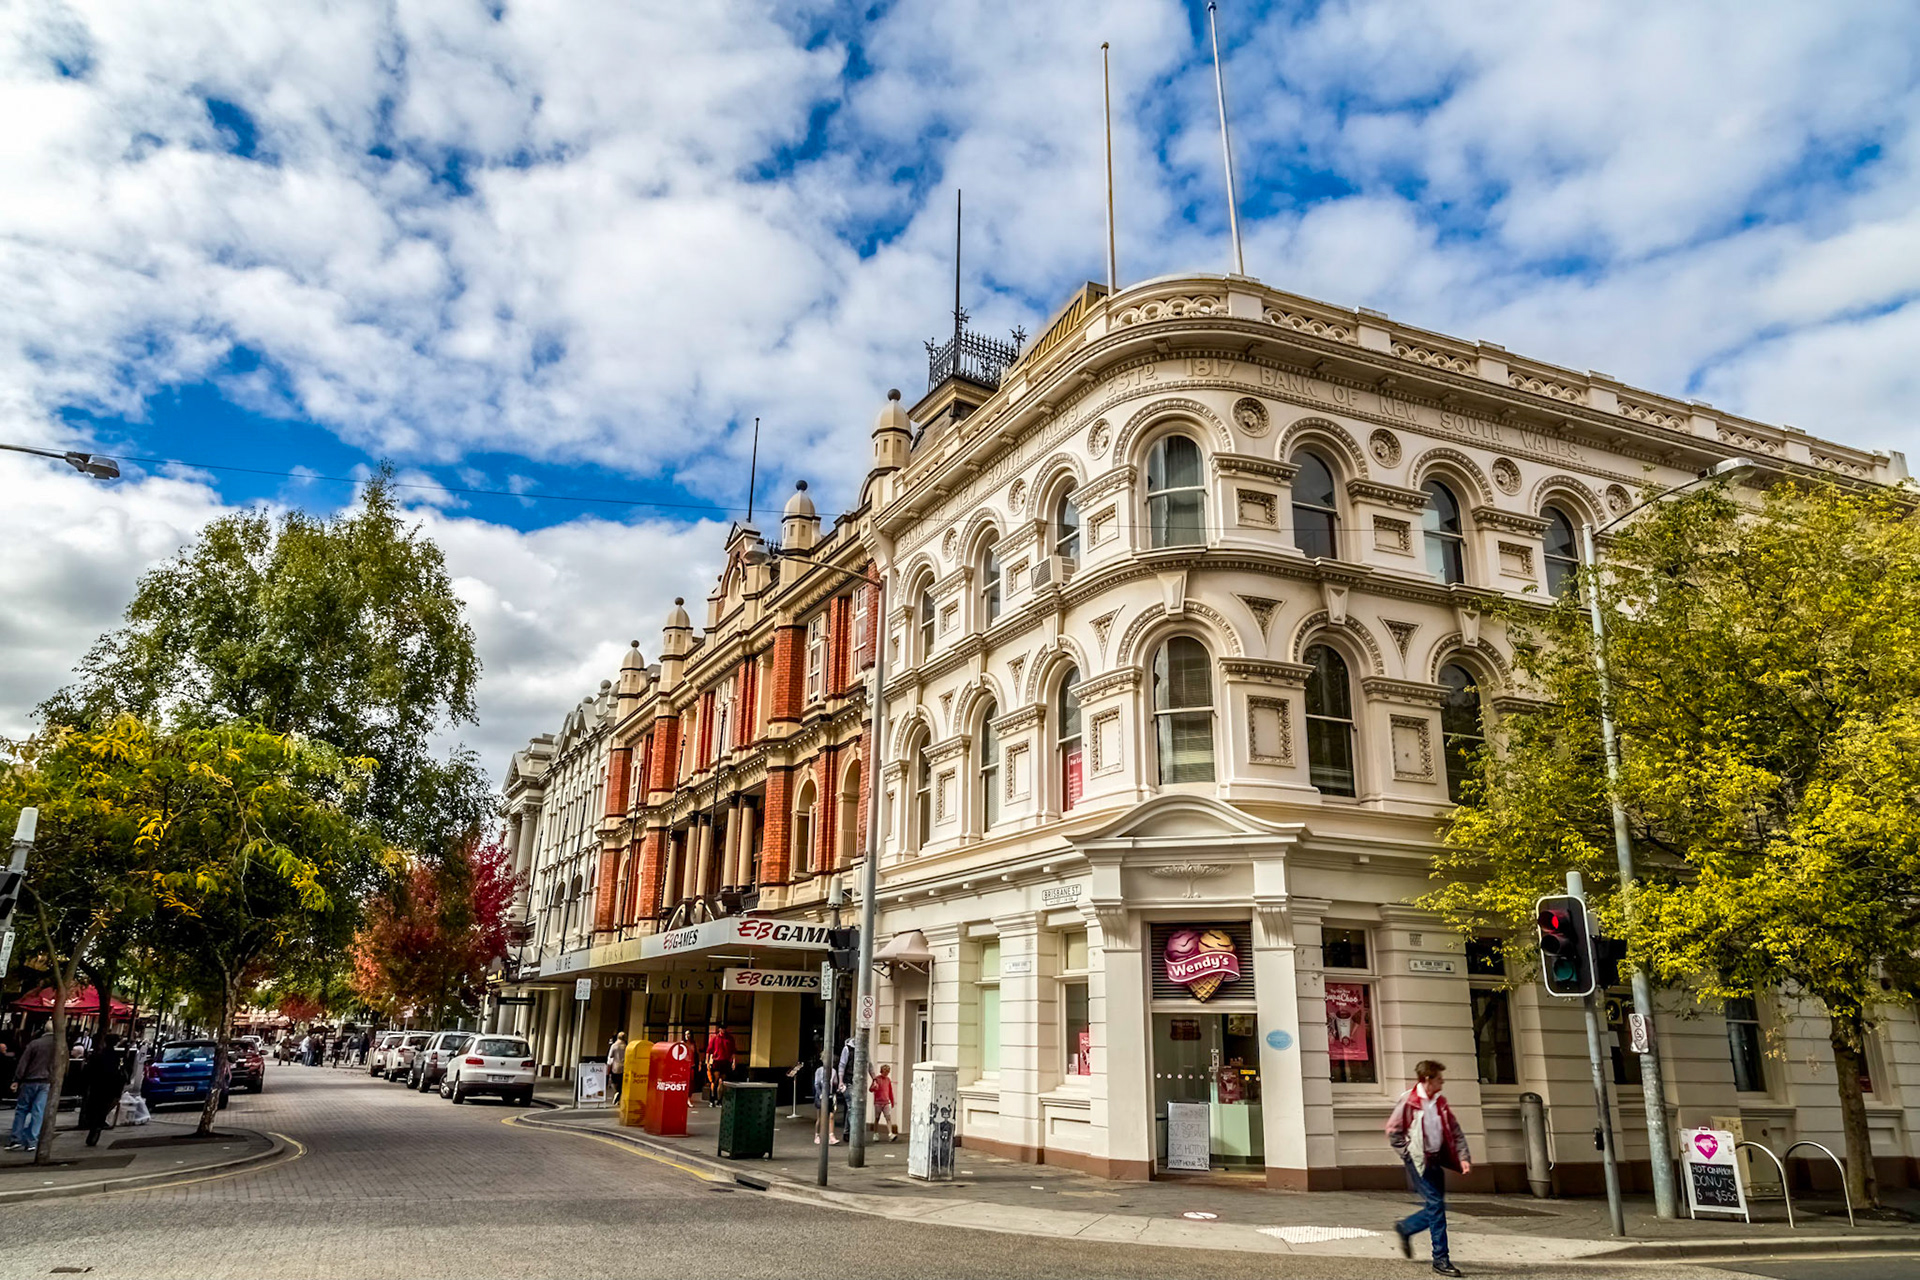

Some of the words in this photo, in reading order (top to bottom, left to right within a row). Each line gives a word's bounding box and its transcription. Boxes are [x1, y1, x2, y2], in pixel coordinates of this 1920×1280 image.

[1184, 358, 1236, 378] 1817
[1259, 366, 1317, 398] BANK
[1332, 384, 1360, 408] OF
[1379, 395, 1418, 422] NEW
[1440, 411, 1504, 443] SOUTH
[987, 445, 1024, 486] SOUTH
[1044, 887, 1071, 900] BRISBANE
[1072, 886, 1079, 896] ST
[1172, 955, 1230, 978] Wendy's
[760, 974, 820, 989] GAMES
[665, 1083, 687, 1091] POST
[1692, 1164, 1706, 1174] HOT
[1693, 1174, 1736, 1191] DONUTS
[1696, 1188, 1703, 1200] 6
